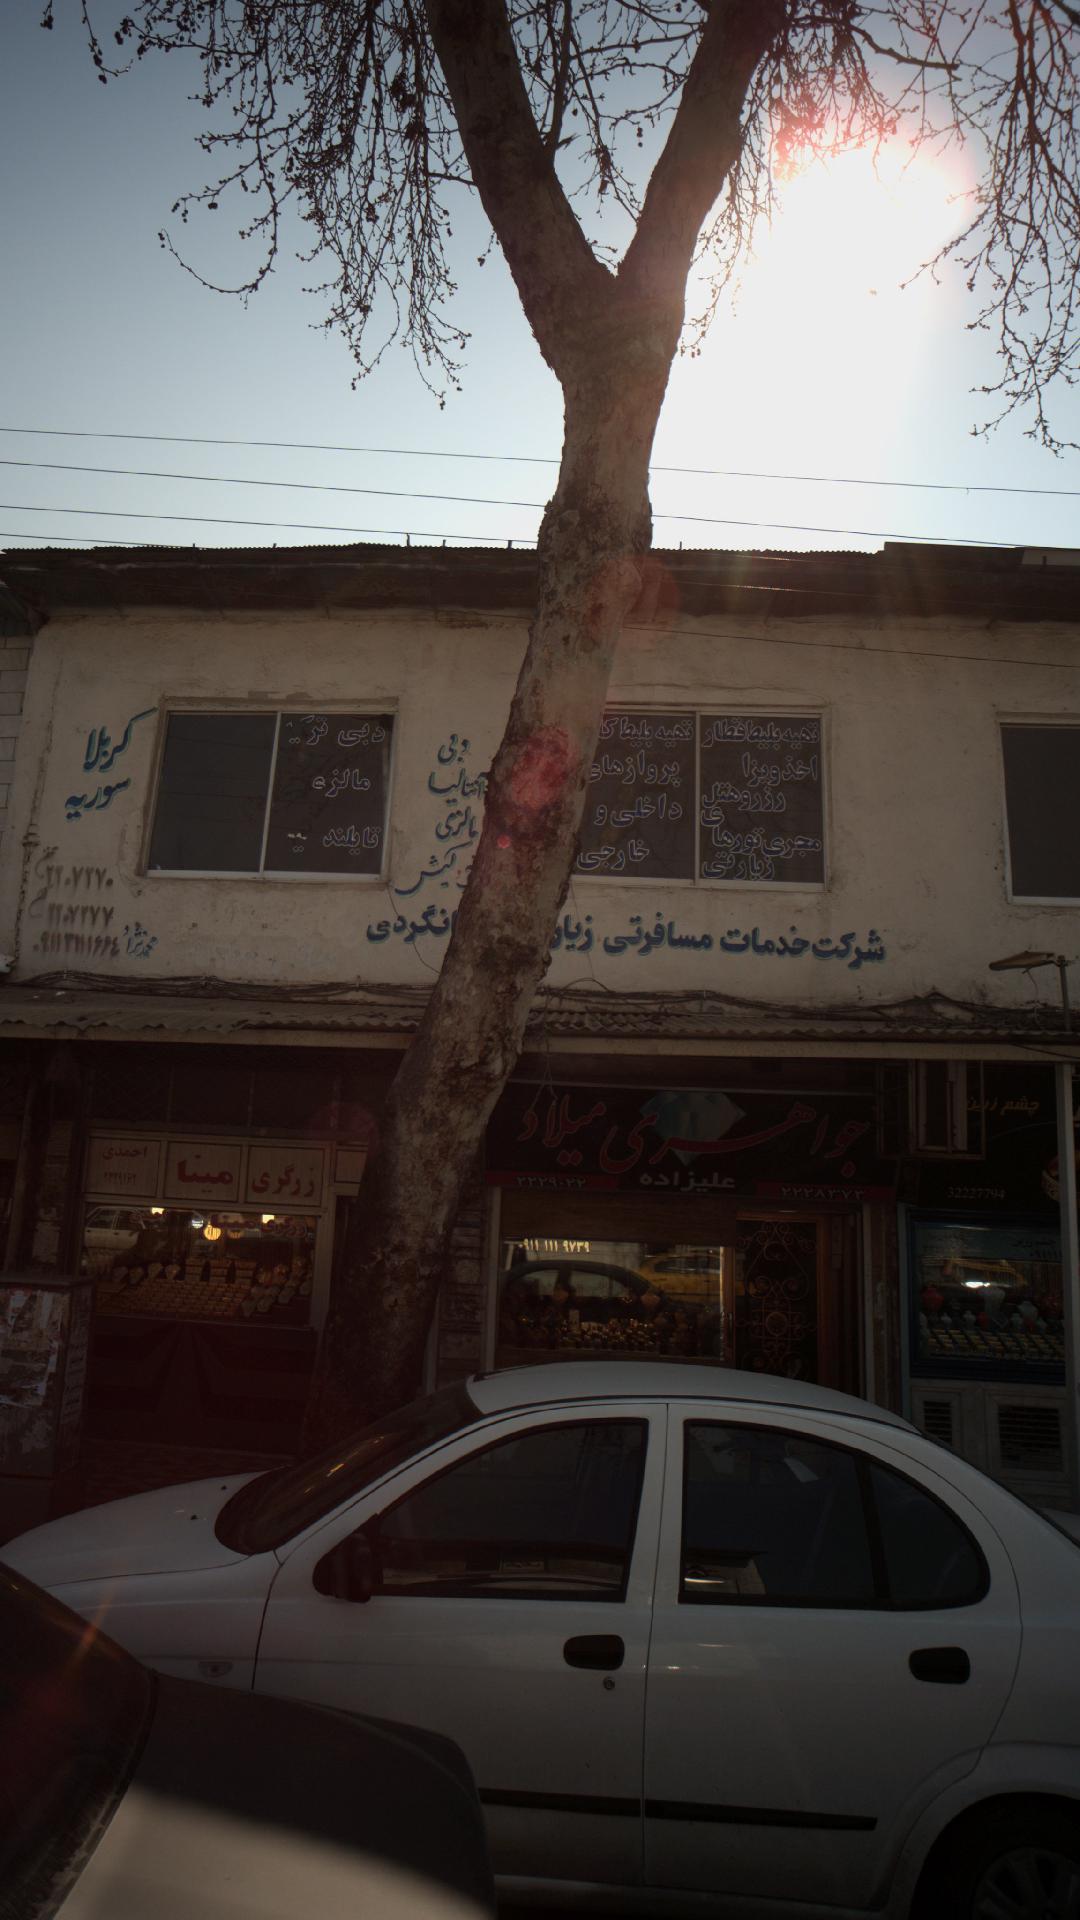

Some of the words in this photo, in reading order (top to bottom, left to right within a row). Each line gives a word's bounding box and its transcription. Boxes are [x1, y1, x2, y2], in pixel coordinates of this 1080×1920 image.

[83, 706, 159, 772] کربلا
[337, 722, 386, 747] دبی
[437, 733, 470, 764] دبی
[742, 752, 780, 786] ویزا
[783, 753, 818, 781] اخذ
[65, 777, 131, 822] سوریه
[610, 792, 683, 828] داخلی
[322, 825, 382, 856] تایلند
[576, 839, 650, 871] خارجی
[762, 835, 821, 859] مجری
[394, 840, 473, 896] کیش
[703, 850, 776, 881] زیارتی
[549, 914, 595, 953] زیار
[602, 911, 714, 955] مسافرتی
[719, 925, 809, 956] خدمات
[811, 928, 886, 970] شرکت
[516, 1092, 607, 1167] میلاد
[102, 1146, 148, 1160] احمدی
[177, 1154, 234, 1193] مینا
[251, 1163, 315, 1198] زرگری
[639, 1171, 736, 1193] علیزاده
